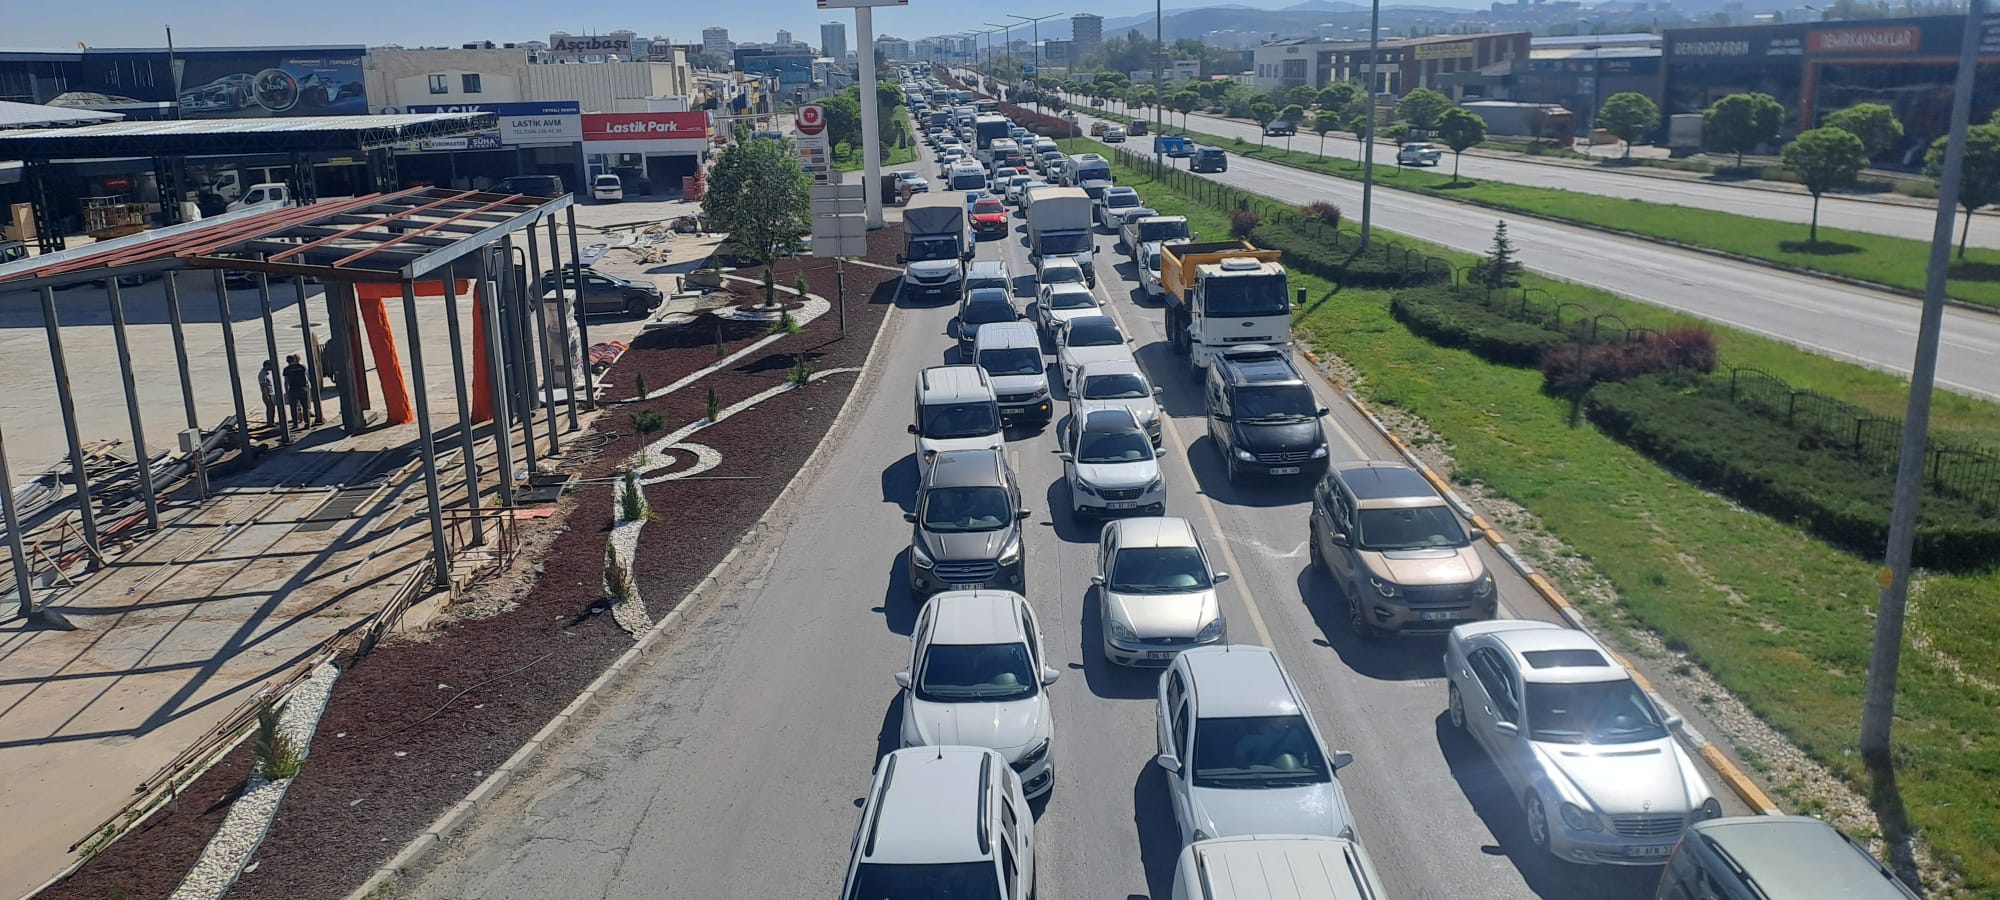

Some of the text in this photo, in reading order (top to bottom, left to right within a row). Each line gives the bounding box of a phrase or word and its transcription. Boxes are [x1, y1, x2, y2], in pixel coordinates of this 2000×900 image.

[555, 37, 629, 53] Aşçıbaşı
[543, 119, 562, 127] AVM
[606, 120, 678, 133] Lastik Park
